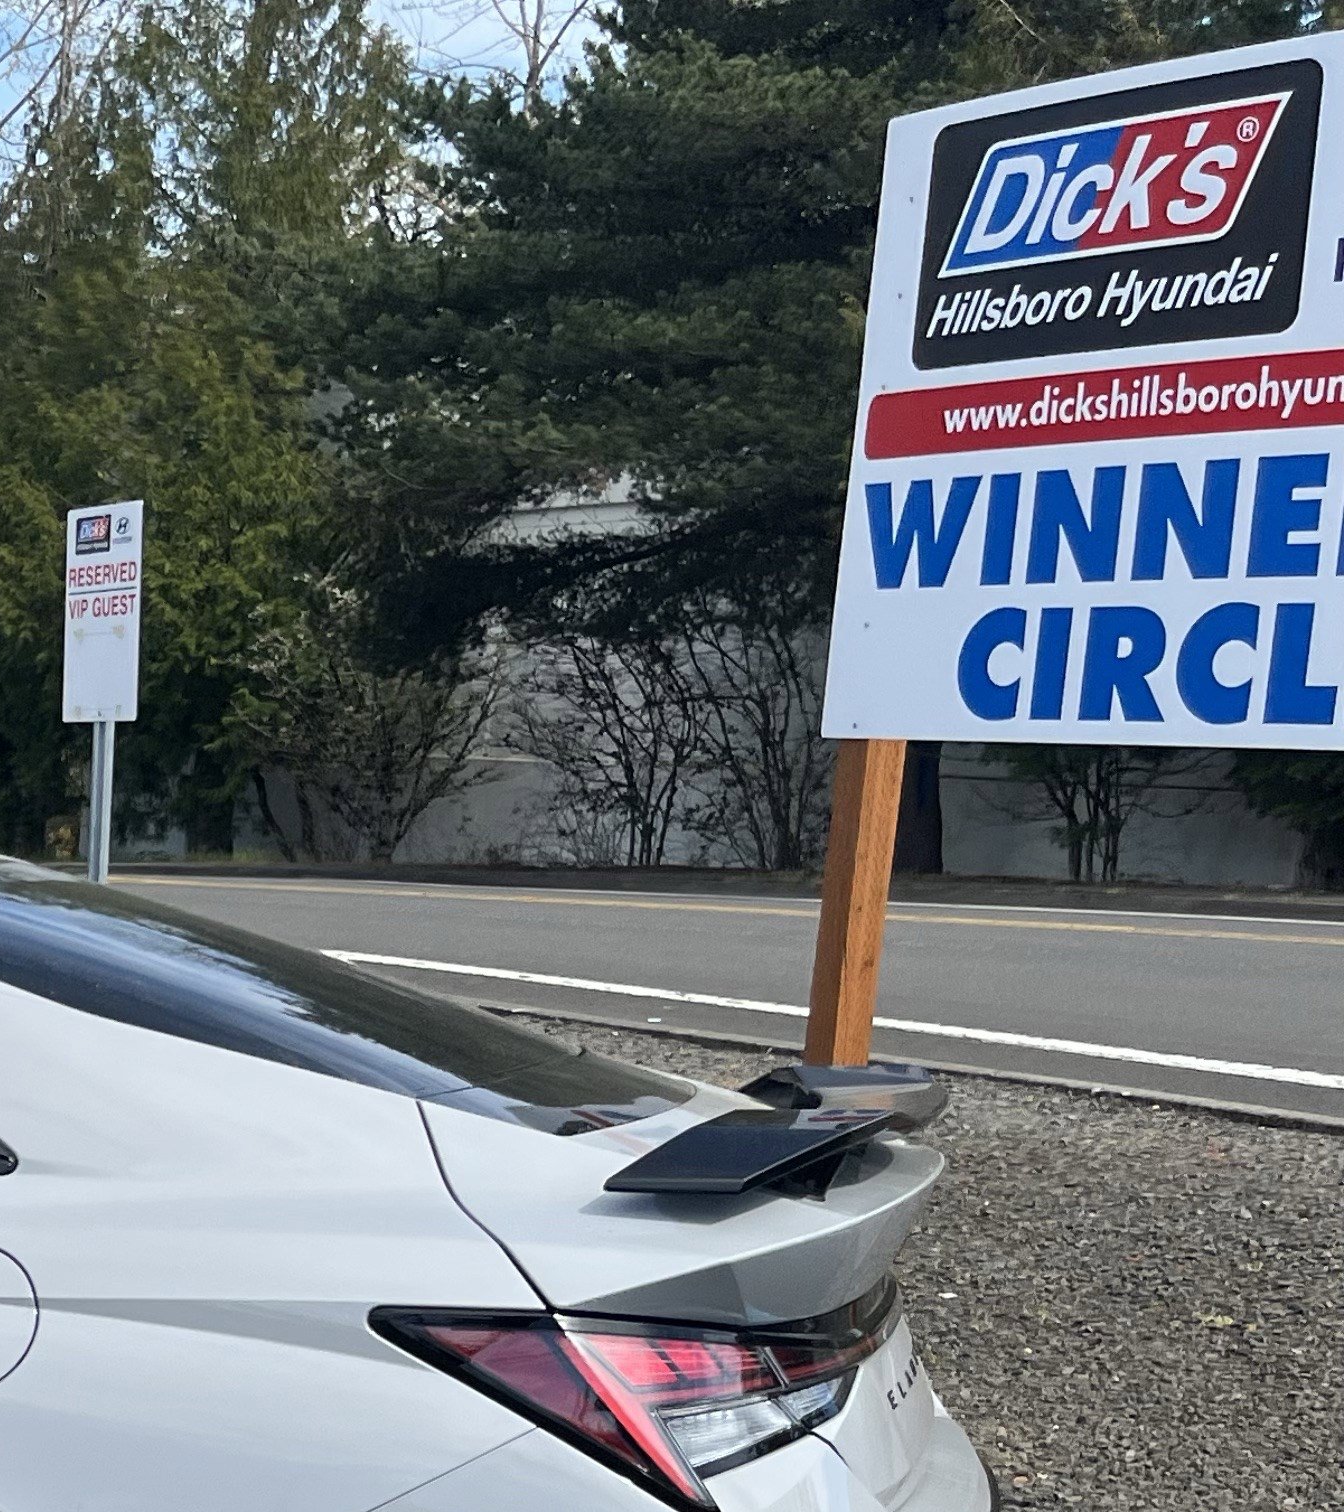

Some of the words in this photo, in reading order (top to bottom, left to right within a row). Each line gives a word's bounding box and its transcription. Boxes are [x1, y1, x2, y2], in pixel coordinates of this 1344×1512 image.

[926, 284, 1093, 338] Hillsboro
[1097, 252, 1280, 328] Hyundai
[943, 365, 1344, 435] www.dickshillsborohyun
[864, 453, 1344, 590] WINNE
[68, 561, 137, 588] RESERVED
[69, 599, 88, 619] VIP
[92, 594, 136, 618] GUEST
[957, 602, 1339, 725] CIRCL
